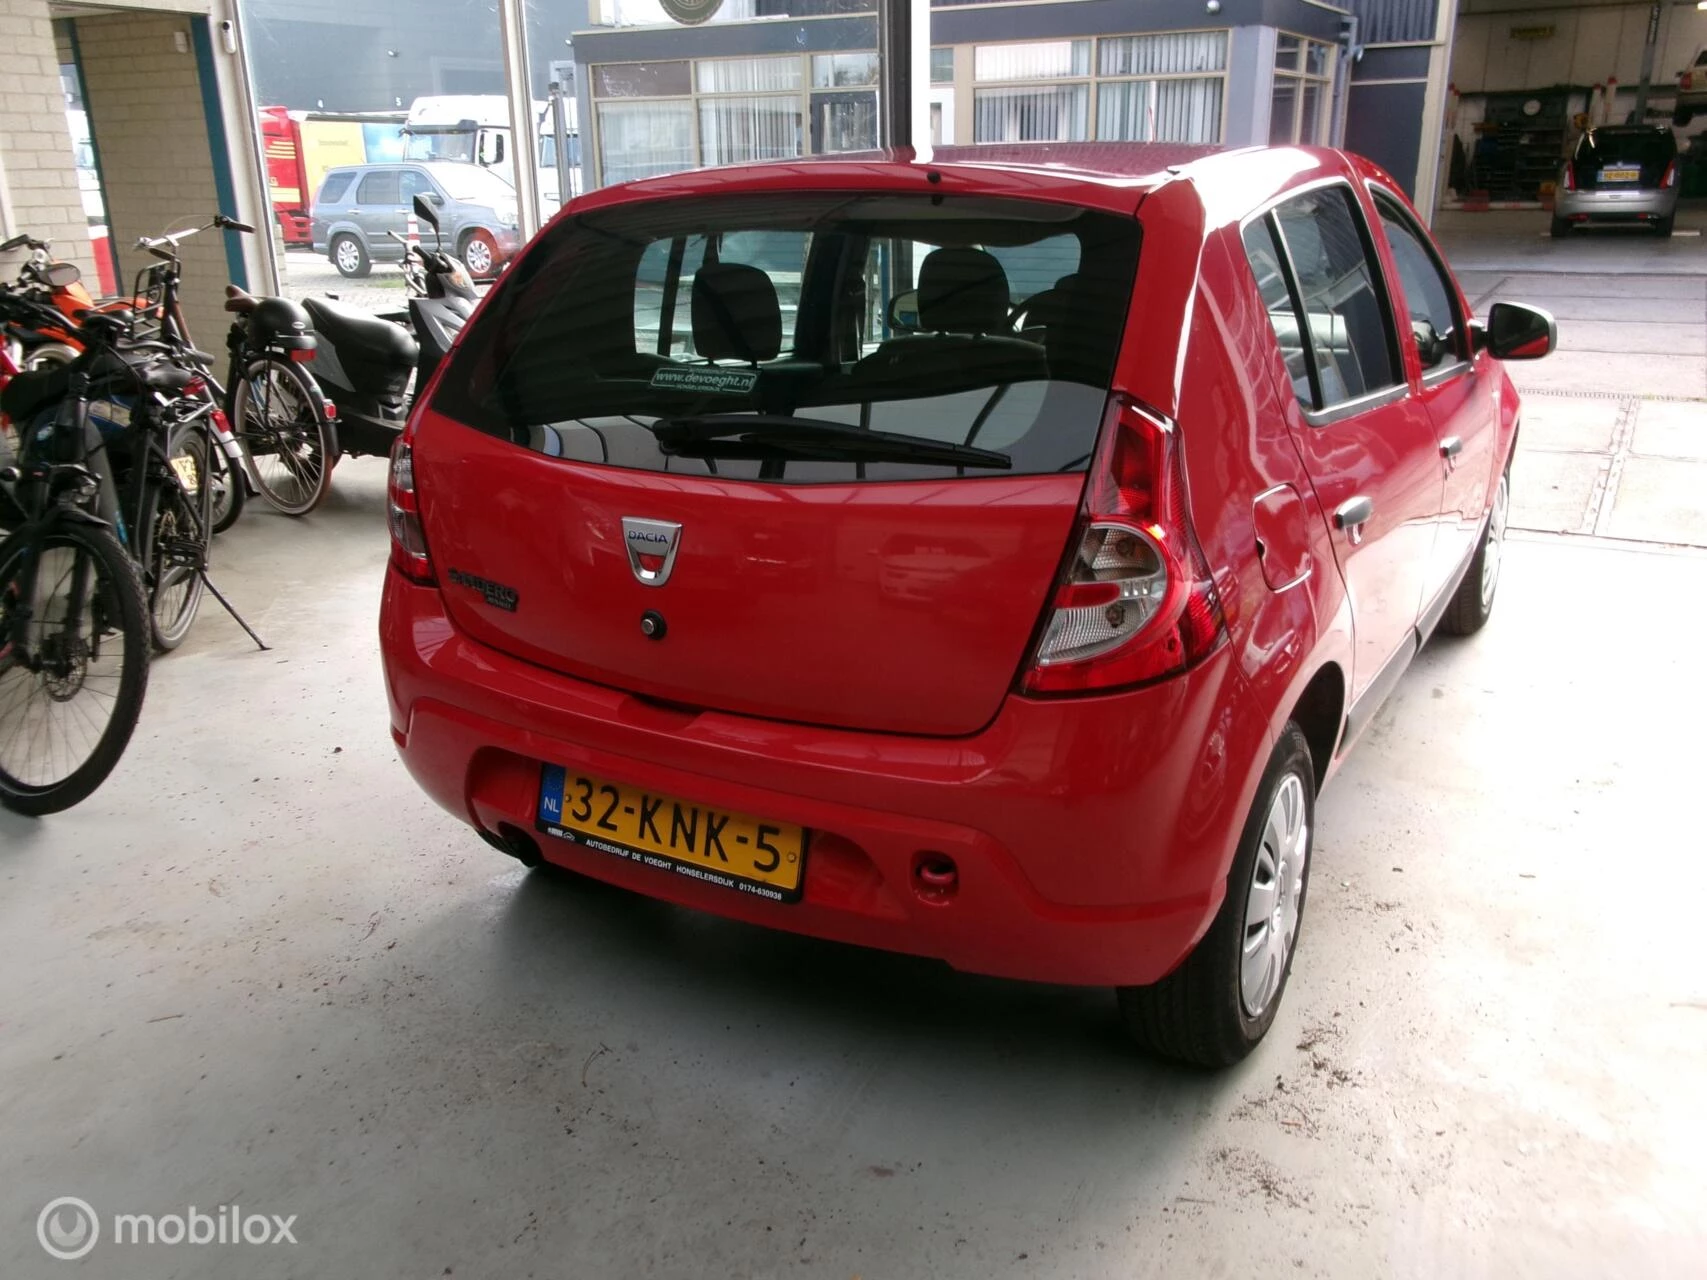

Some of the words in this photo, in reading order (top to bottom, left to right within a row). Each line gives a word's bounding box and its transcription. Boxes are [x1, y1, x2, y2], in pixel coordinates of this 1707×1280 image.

[655, 372, 756, 387] www.devoeght.nl
[628, 529, 668, 544] DACIA
[543, 797, 560, 813] NL
[571, 777, 781, 873] 32-KNK-5
[585, 839, 630, 857] AUTOBEDRIJF
[631, 852, 642, 861] DE
[644, 855, 672, 870] VOEGHT
[676, 864, 734, 888] HONSELERSDIJK
